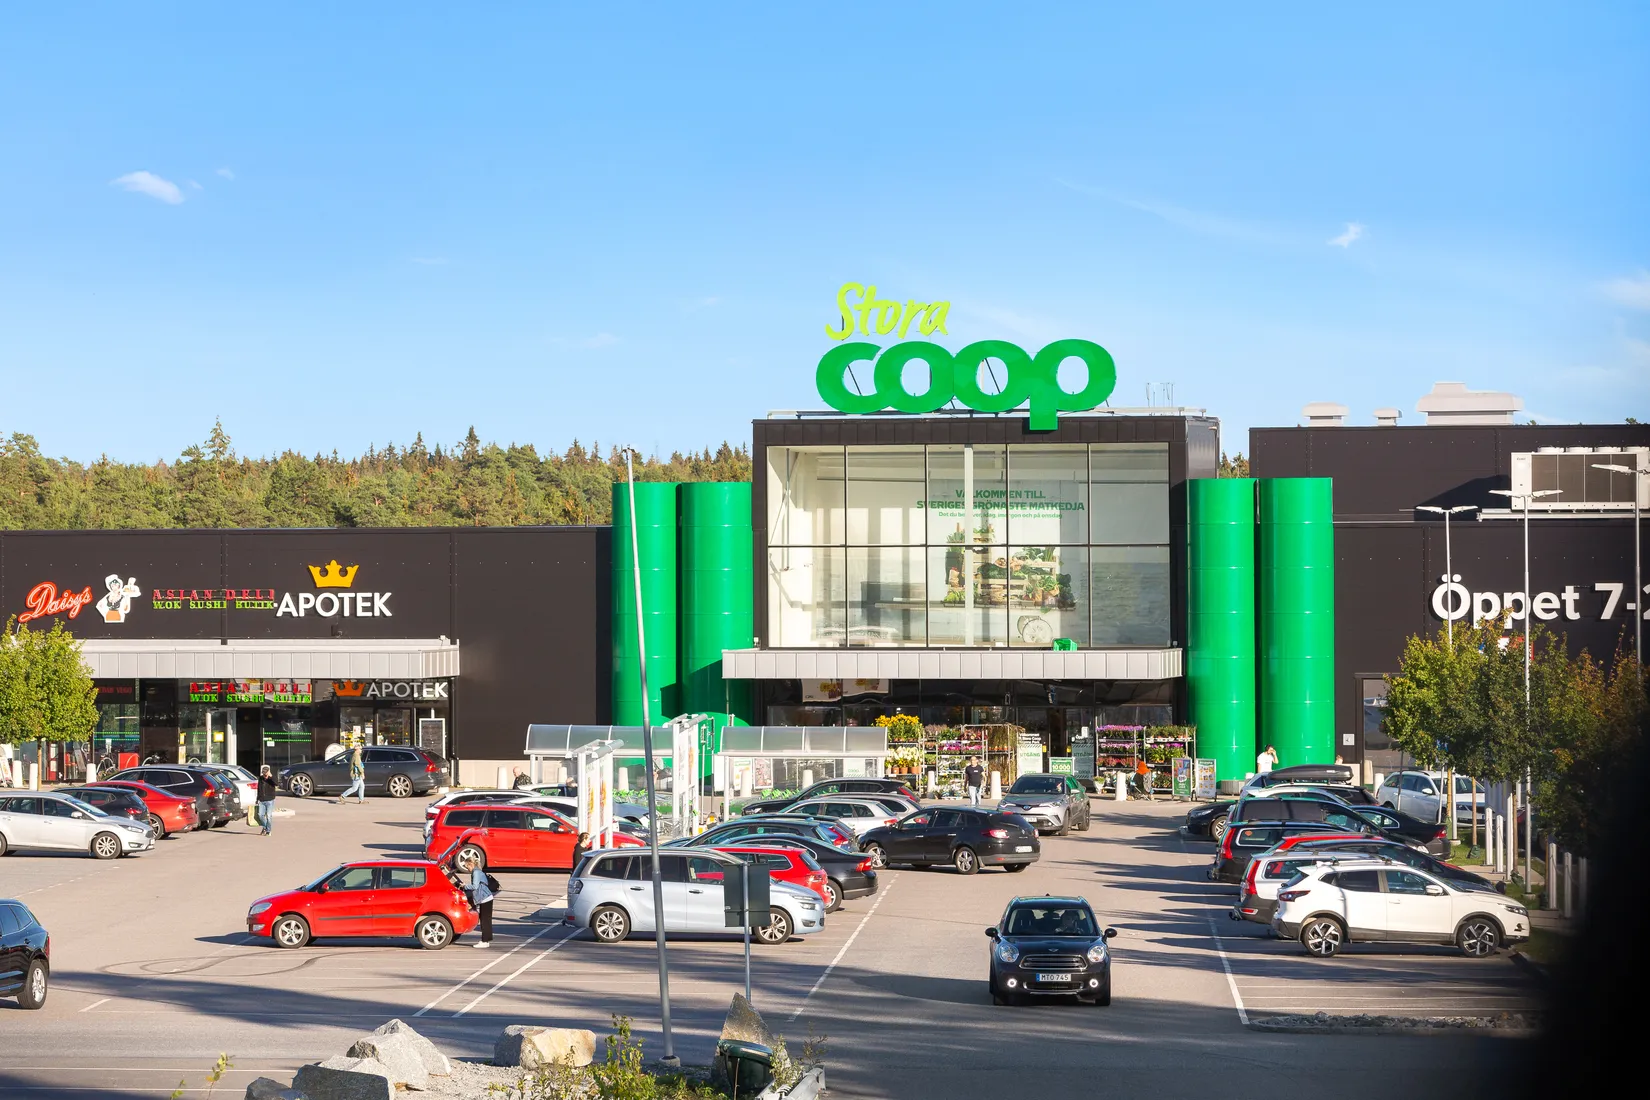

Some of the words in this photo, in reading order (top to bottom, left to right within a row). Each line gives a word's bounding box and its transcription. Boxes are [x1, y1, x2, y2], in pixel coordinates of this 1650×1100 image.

[825, 282, 950, 340] Stora
[815, 338, 1116, 431] coop
[955, 489, 1023, 499] VKOMMEN
[1024, 490, 1046, 499] TILL
[1029, 501, 1085, 511] MATKEDJA
[152, 589, 213, 600] ASIAN
[225, 589, 275, 600] DELI
[18, 581, 93, 622] Daisy's
[152, 600, 182, 609] WOK
[189, 600, 227, 609] SUSHI
[235, 600, 274, 609] BUTIK
[275, 592, 393, 617] APOTEK
[1431, 573, 1581, 630] Öppet
[189, 682, 251, 693] ASIAN
[262, 683, 312, 693] DELI
[366, 682, 448, 698] APOTEK
[189, 694, 218, 702] WOK
[226, 694, 265, 702] SUSHI
[273, 694, 311, 703] BUTIK
